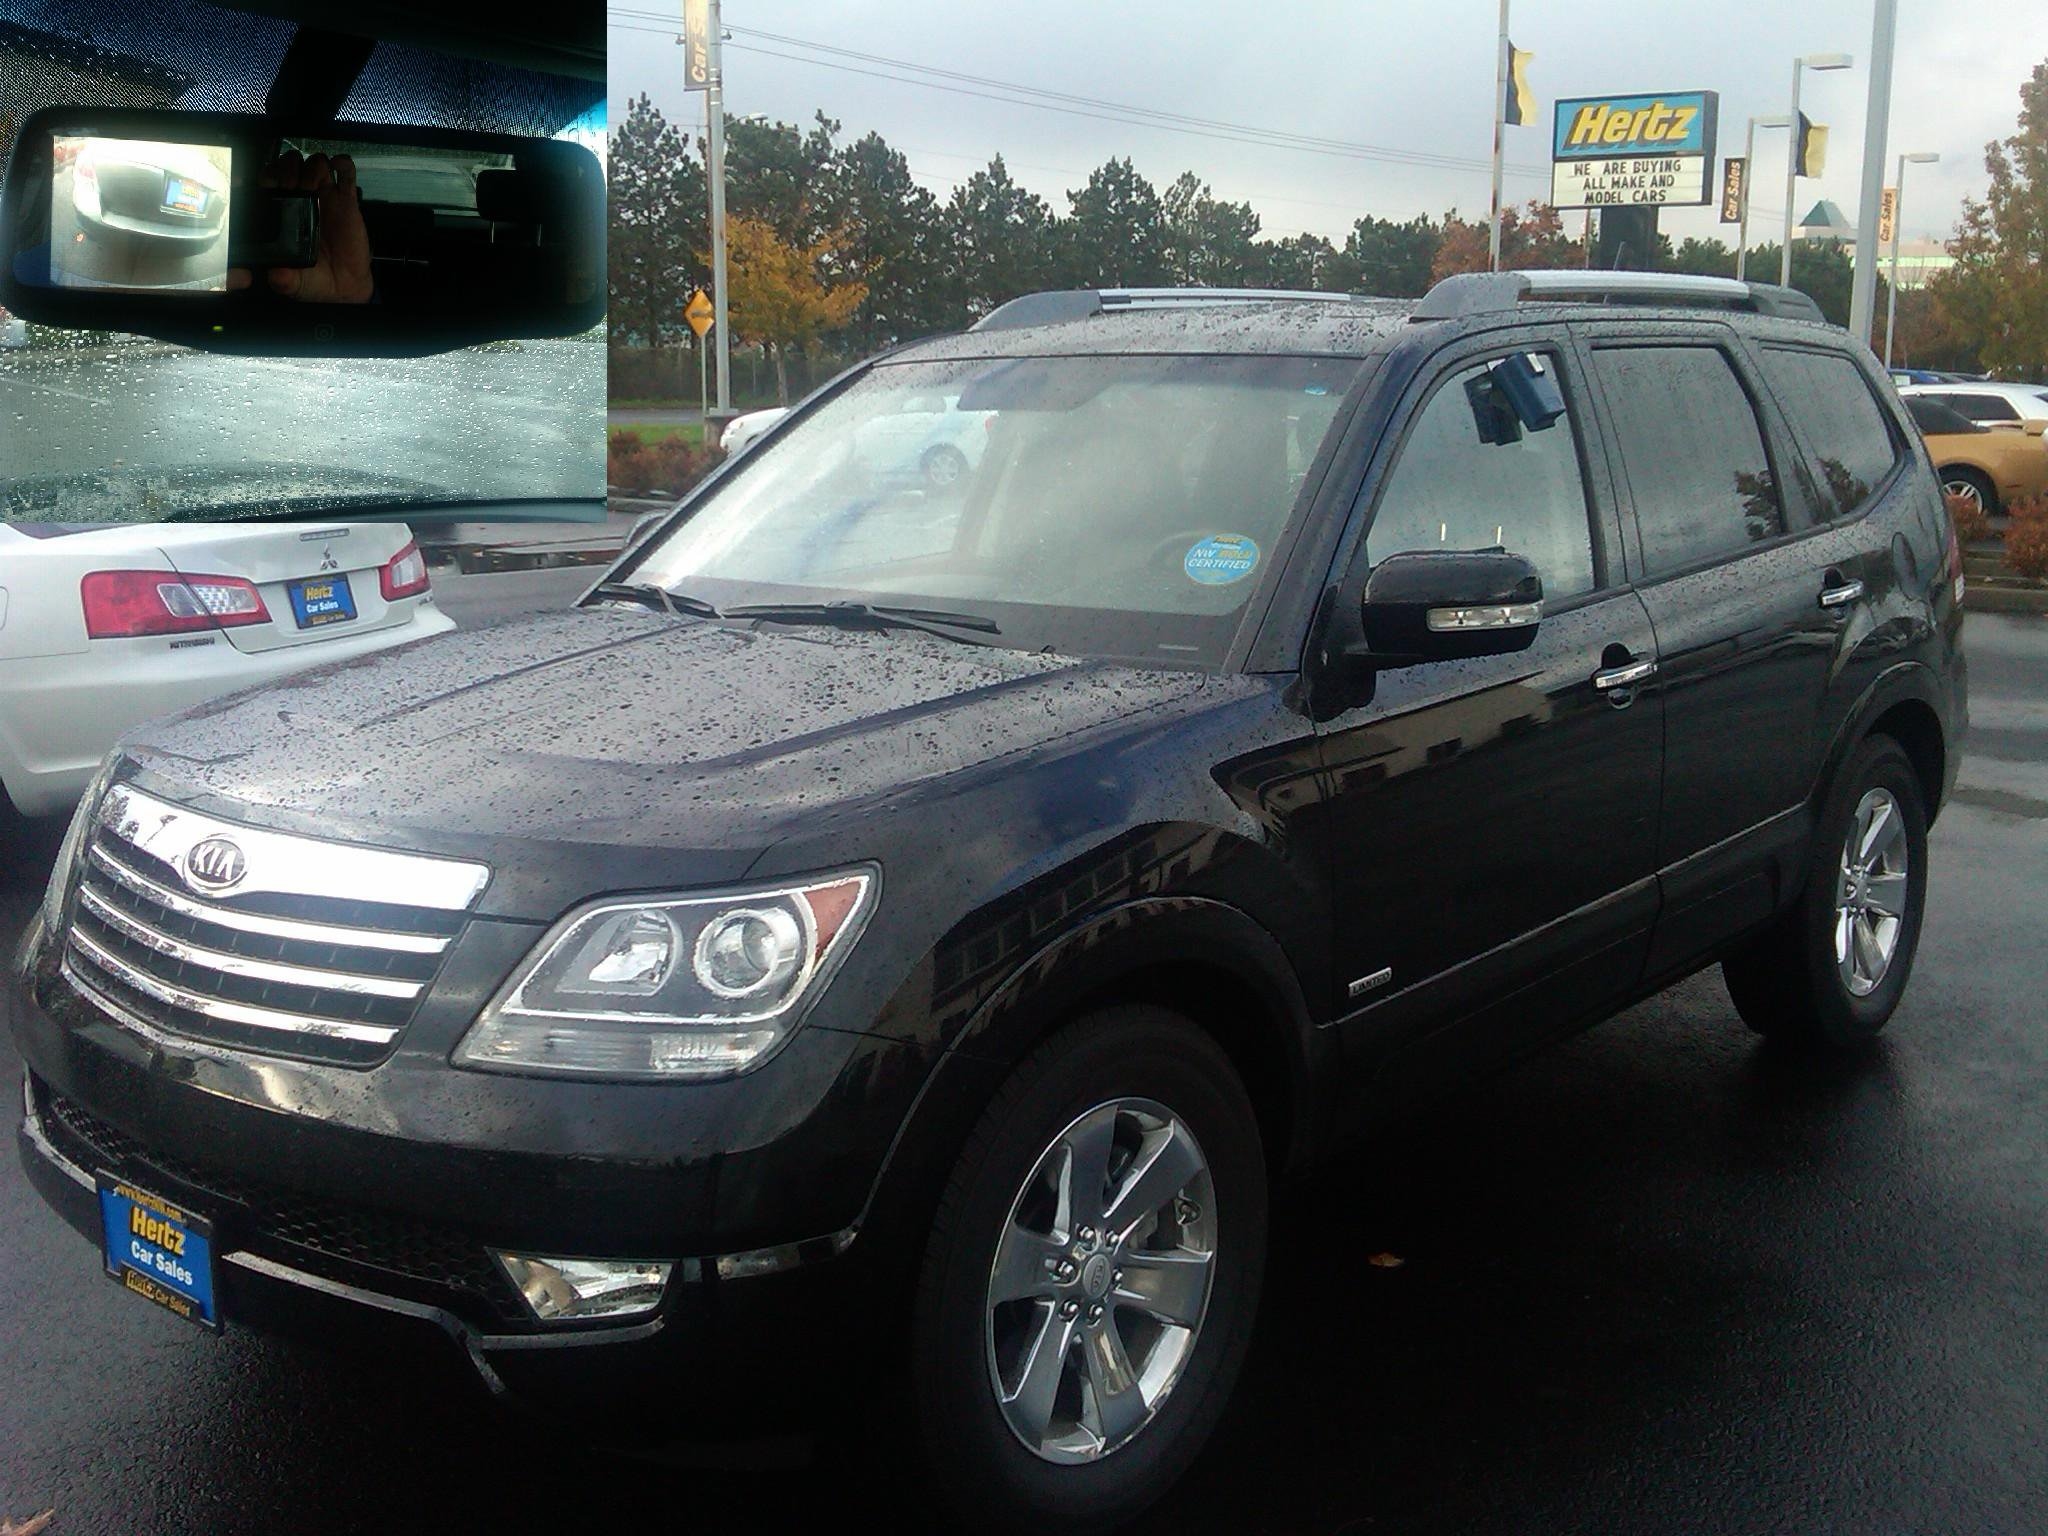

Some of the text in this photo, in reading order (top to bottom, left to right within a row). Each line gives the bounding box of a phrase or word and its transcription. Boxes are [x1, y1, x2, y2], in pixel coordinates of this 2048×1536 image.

[1565, 101, 1698, 147] Hertz
[1574, 159, 1681, 176] WE ARE BUYING
[1583, 174, 1675, 190] ALL MAKE AND
[1725, 161, 1741, 220] Car Sales
[1584, 189, 1667, 204] MODEL CARS
[1880, 192, 1893, 242] Car Sales
[1187, 558, 1251, 570] CERTIFIED
[304, 585, 334, 601] Hertz
[306, 600, 339, 613] Car Sales
[130, 1205, 187, 1256] Hertz
[131, 1240, 193, 1286] Car Sales
